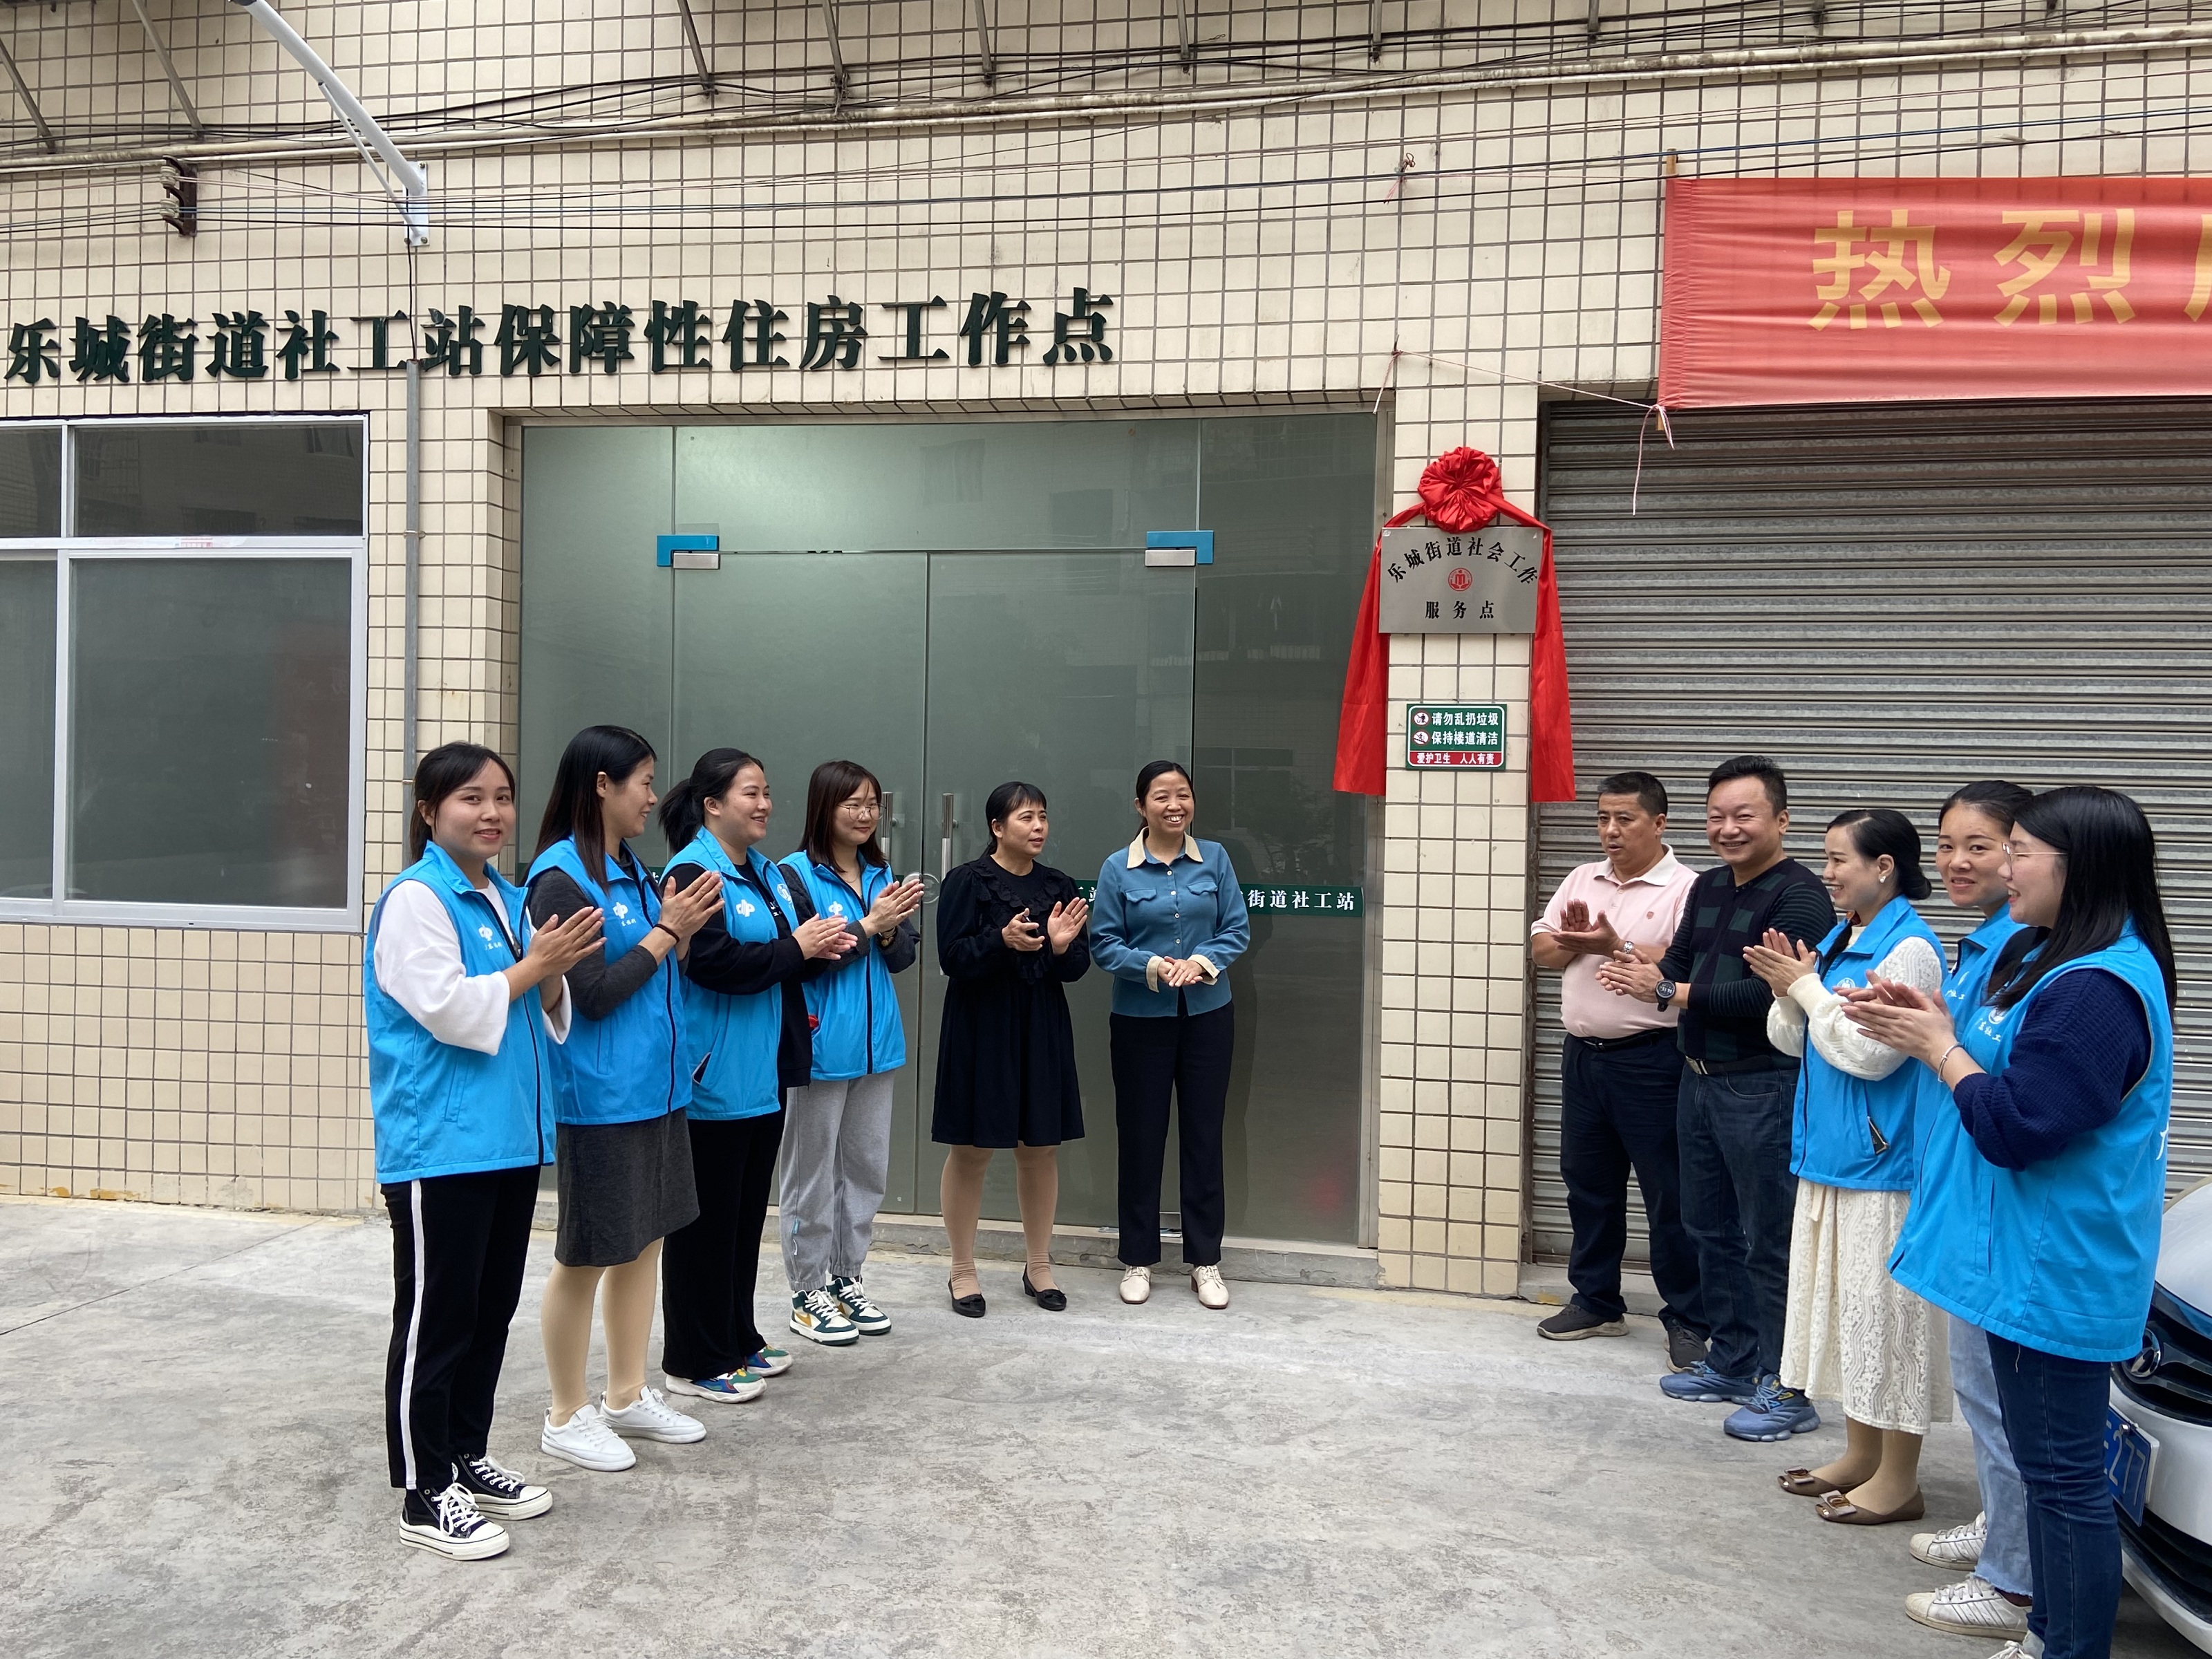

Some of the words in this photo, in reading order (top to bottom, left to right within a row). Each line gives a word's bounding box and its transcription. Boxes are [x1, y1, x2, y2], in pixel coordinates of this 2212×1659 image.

[1807, 207, 2212, 330] 热烈
[3, 286, 1114, 384] 乐城街道社工站保障性住房工作点
[1387, 536, 1538, 583] 乐城街道社会工作
[1425, 600, 1494, 619] 服务点
[1432, 712, 1499, 726] 请勿乱扔垃圾
[1432, 731, 1499, 745] 保持楼道清洁
[1416, 752, 1451, 765] 爱护卫生
[1460, 752, 1494, 765] 人人有责
[1240, 889, 1355, 910] 街道社工站
